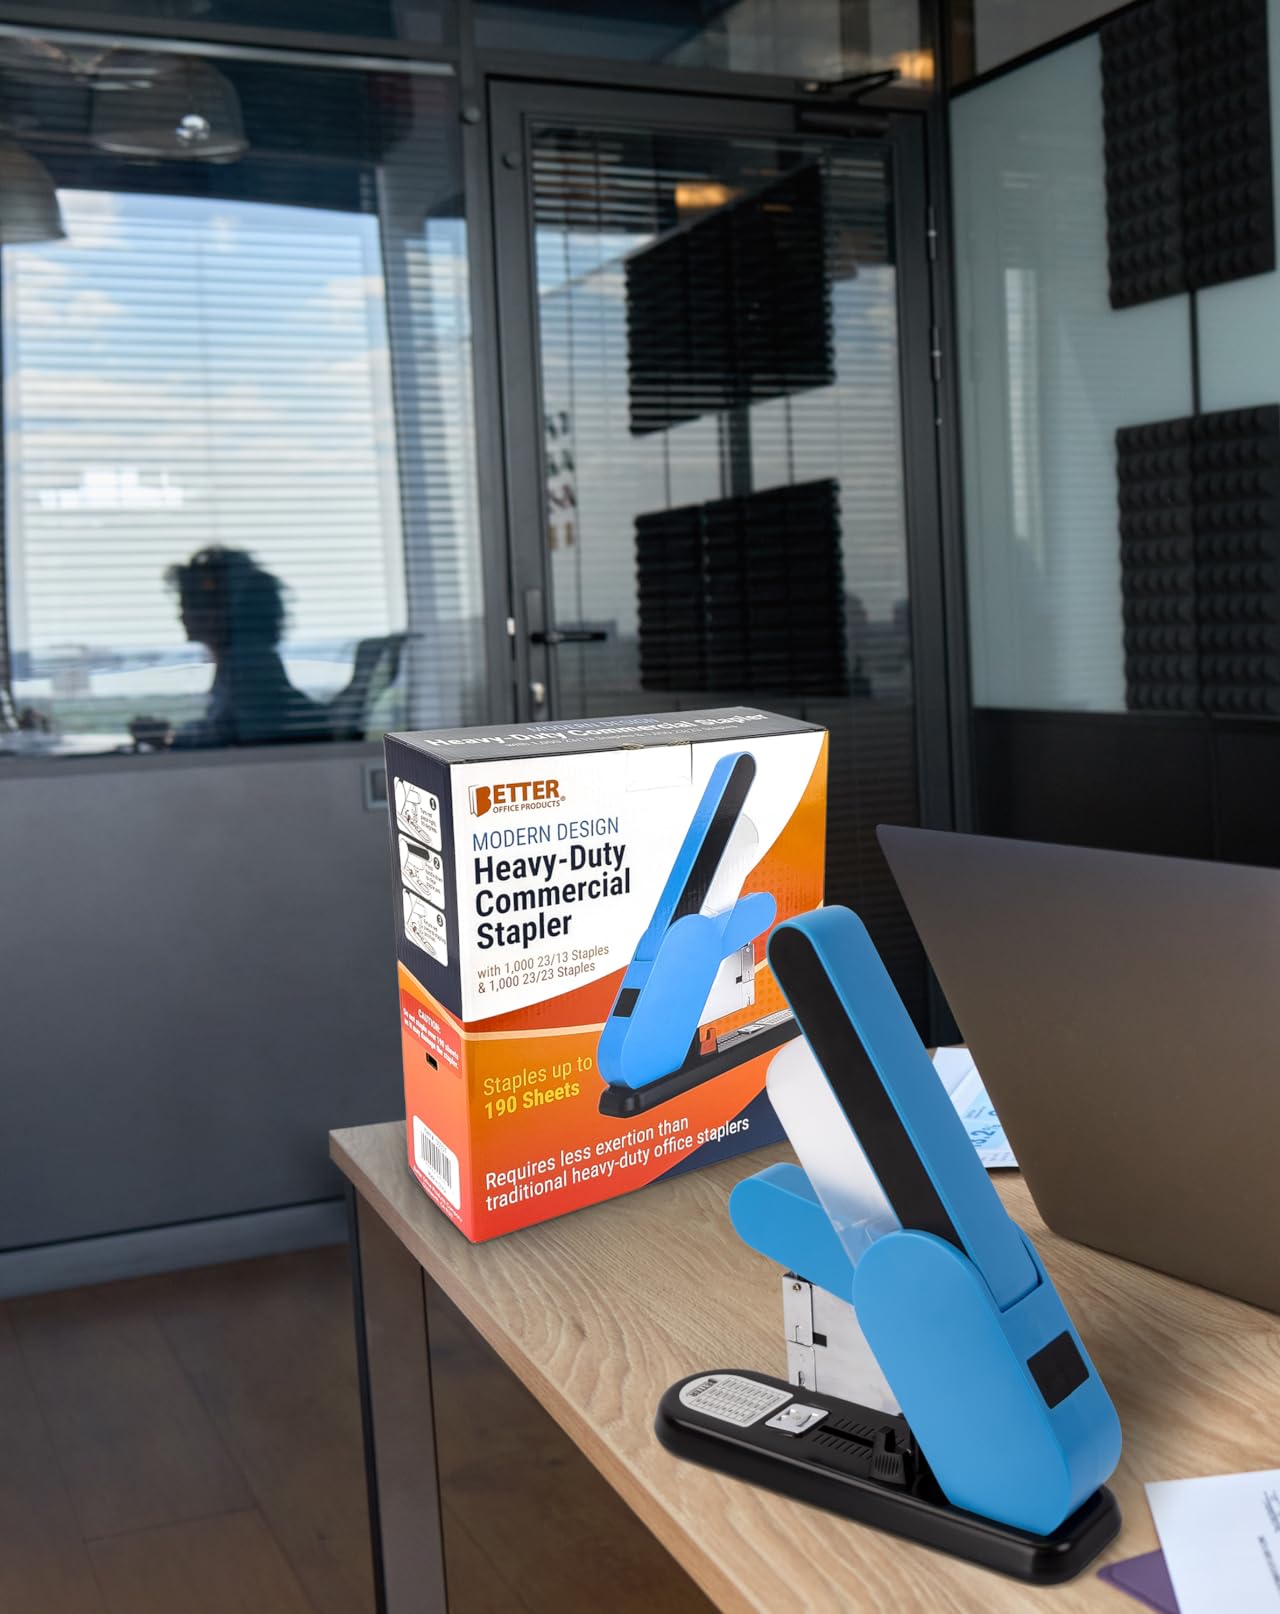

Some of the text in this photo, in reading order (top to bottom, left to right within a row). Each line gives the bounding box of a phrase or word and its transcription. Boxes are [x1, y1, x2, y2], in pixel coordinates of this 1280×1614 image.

[424, 713, 768, 746] Heavy-Duty Commercial Stapler
[475, 779, 560, 817] BETTER
[493, 800, 561, 814] OFFICE PRODUCTS
[473, 816, 619, 851] MODERN DESIGN
[474, 842, 626, 885] Heavy-Duty
[475, 867, 630, 917] Commercial
[477, 911, 572, 949] Stapler
[477, 945, 609, 979] with 1,000 23/13 Staples
[478, 961, 596, 994] & 1,000 23/23 Staples
[483, 1056, 593, 1096] Staples up to
[484, 1081, 580, 1119] 190 Sheets
[486, 1117, 689, 1191] Requires less exertion than
[486, 1172, 568, 1212] traditional
[571, 1148, 651, 1185] heavy-duty
[654, 1133, 693, 1158] office
[696, 1117, 750, 1144] staplers
